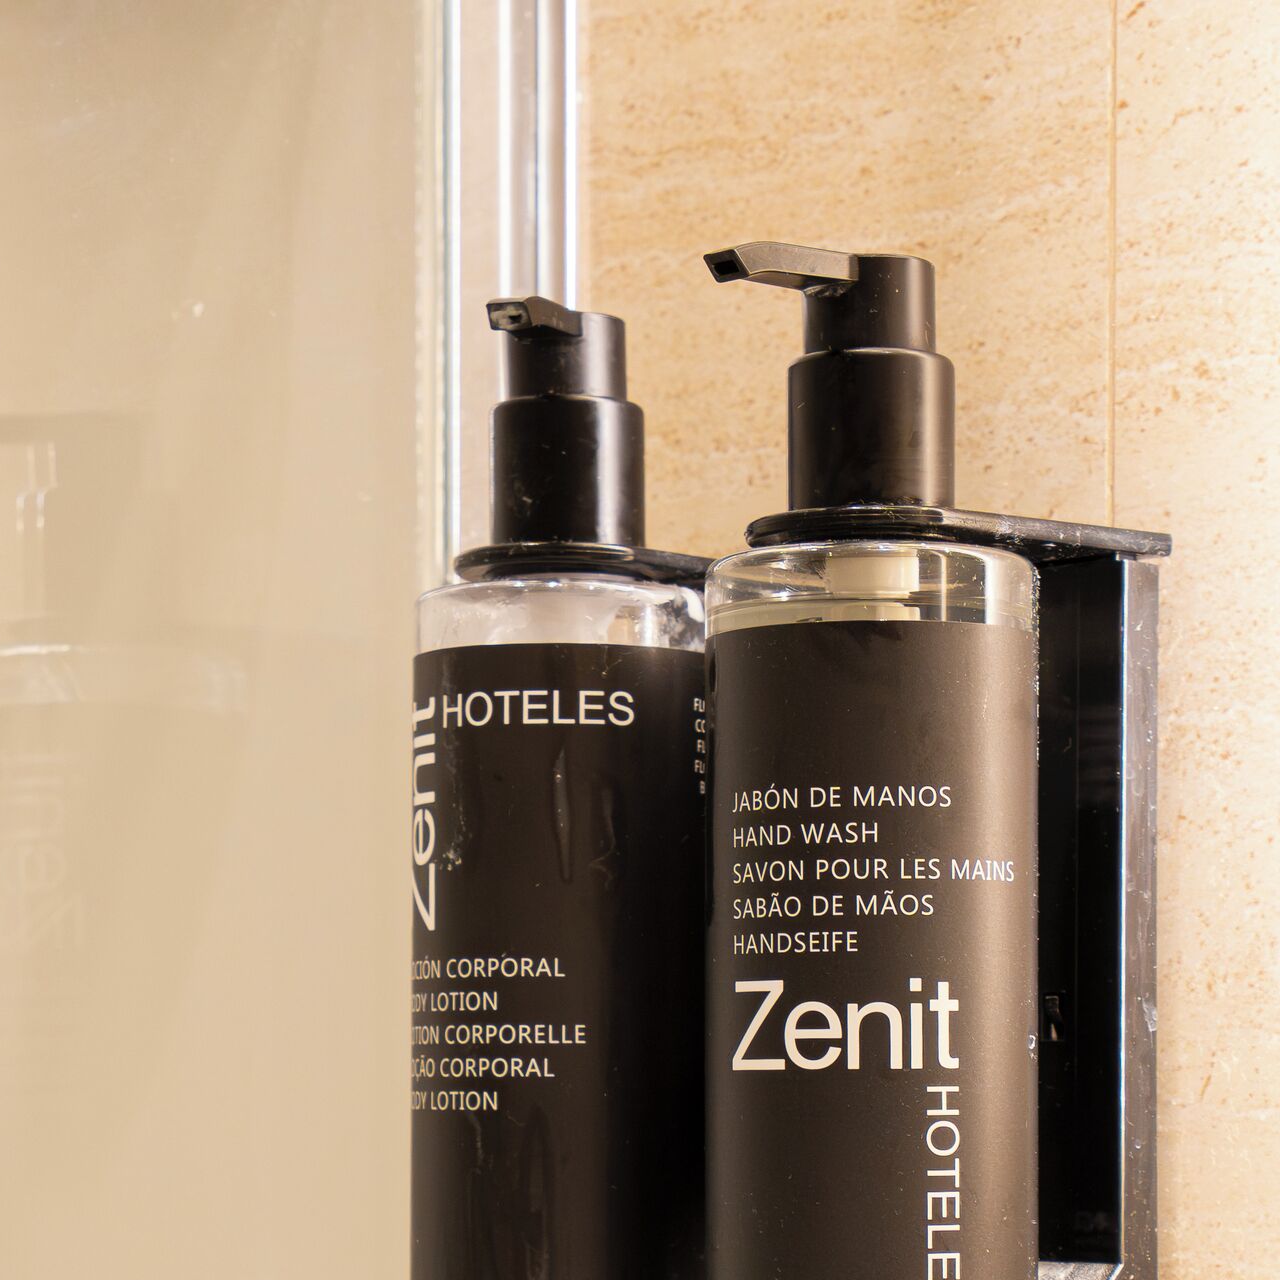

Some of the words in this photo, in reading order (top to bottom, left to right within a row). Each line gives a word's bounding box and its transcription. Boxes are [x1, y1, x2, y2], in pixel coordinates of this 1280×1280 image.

[442, 689, 635, 729] HOTELES
[732, 782, 798, 812] JABÓN
[812, 786, 842, 808] DE
[855, 785, 952, 808] MANOS
[412, 696, 436, 931] Zenit
[734, 824, 792, 848] HAND
[800, 821, 876, 845] WASH
[733, 860, 802, 884] SAVON
[818, 858, 889, 880] POUR
[902, 857, 941, 880] LES
[952, 859, 1015, 882] MAINS
[733, 891, 802, 920] SABÃO
[814, 894, 844, 917] DE
[858, 889, 934, 916] MÃOS
[734, 930, 859, 955] HANDSEIFE
[445, 958, 566, 979] CORPORAL
[430, 991, 498, 1012] LOTION
[444, 1023, 587, 1045] CORPORELLE
[732, 977, 960, 1071] Zenit
[439, 1057, 556, 1078] CORPORAL
[430, 1090, 498, 1111] LOTION
